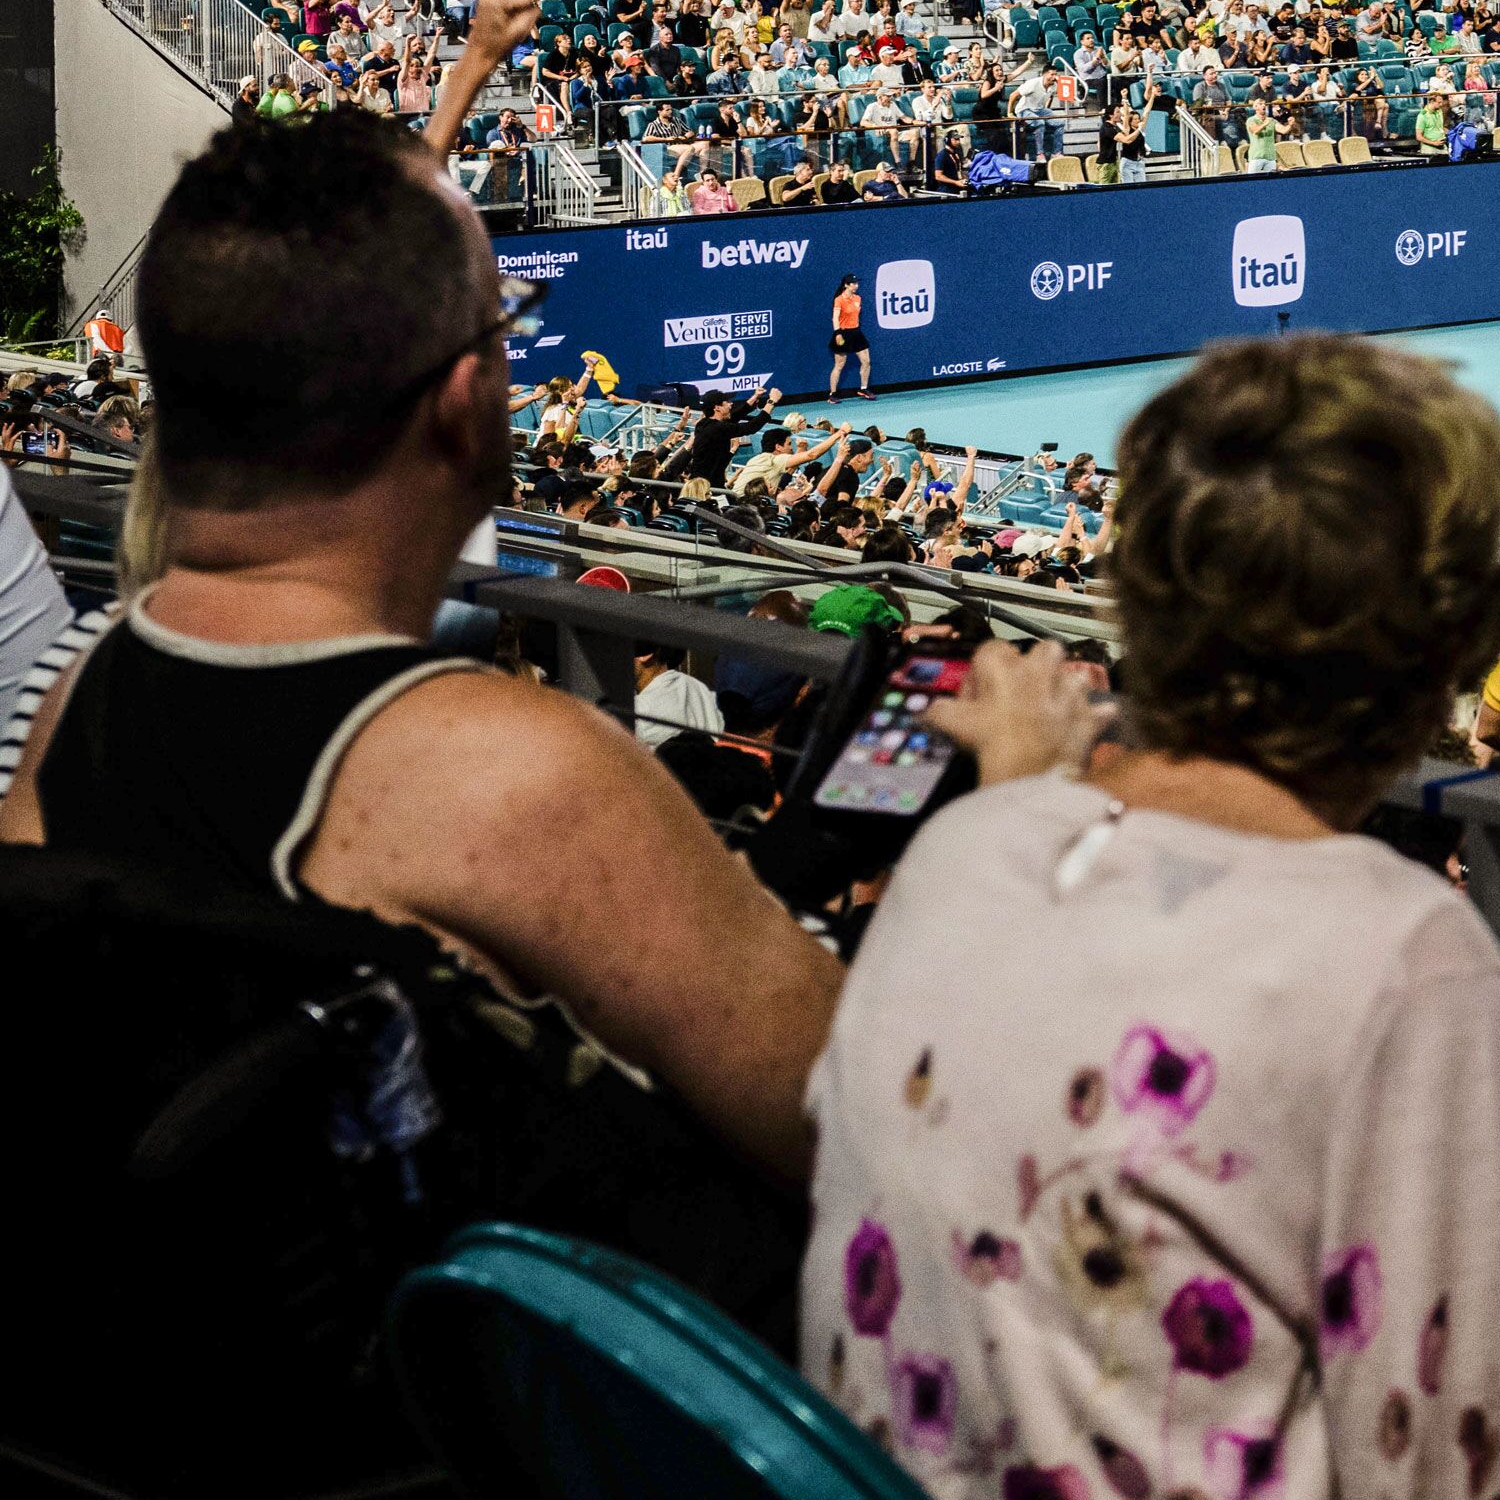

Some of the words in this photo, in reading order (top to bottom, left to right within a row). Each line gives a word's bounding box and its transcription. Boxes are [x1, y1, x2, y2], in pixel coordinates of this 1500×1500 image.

[1062, 85, 1070, 98] B
[540, 115, 549, 129] A
[626, 227, 668, 250] itaú
[1427, 230, 1468, 259] PIF
[498, 250, 578, 269] Dominican
[701, 239, 810, 269] betway
[1066, 262, 1114, 292] PIF
[1239, 253, 1298, 289] itaú
[881, 288, 929, 317] itaú
[734, 313, 769, 325] SERVE
[666, 321, 729, 344] Venus
[734, 325, 769, 337] SPEED
[705, 343, 746, 377] 99
[932, 361, 983, 377] LACOSTE
[731, 376, 761, 391] MPH
